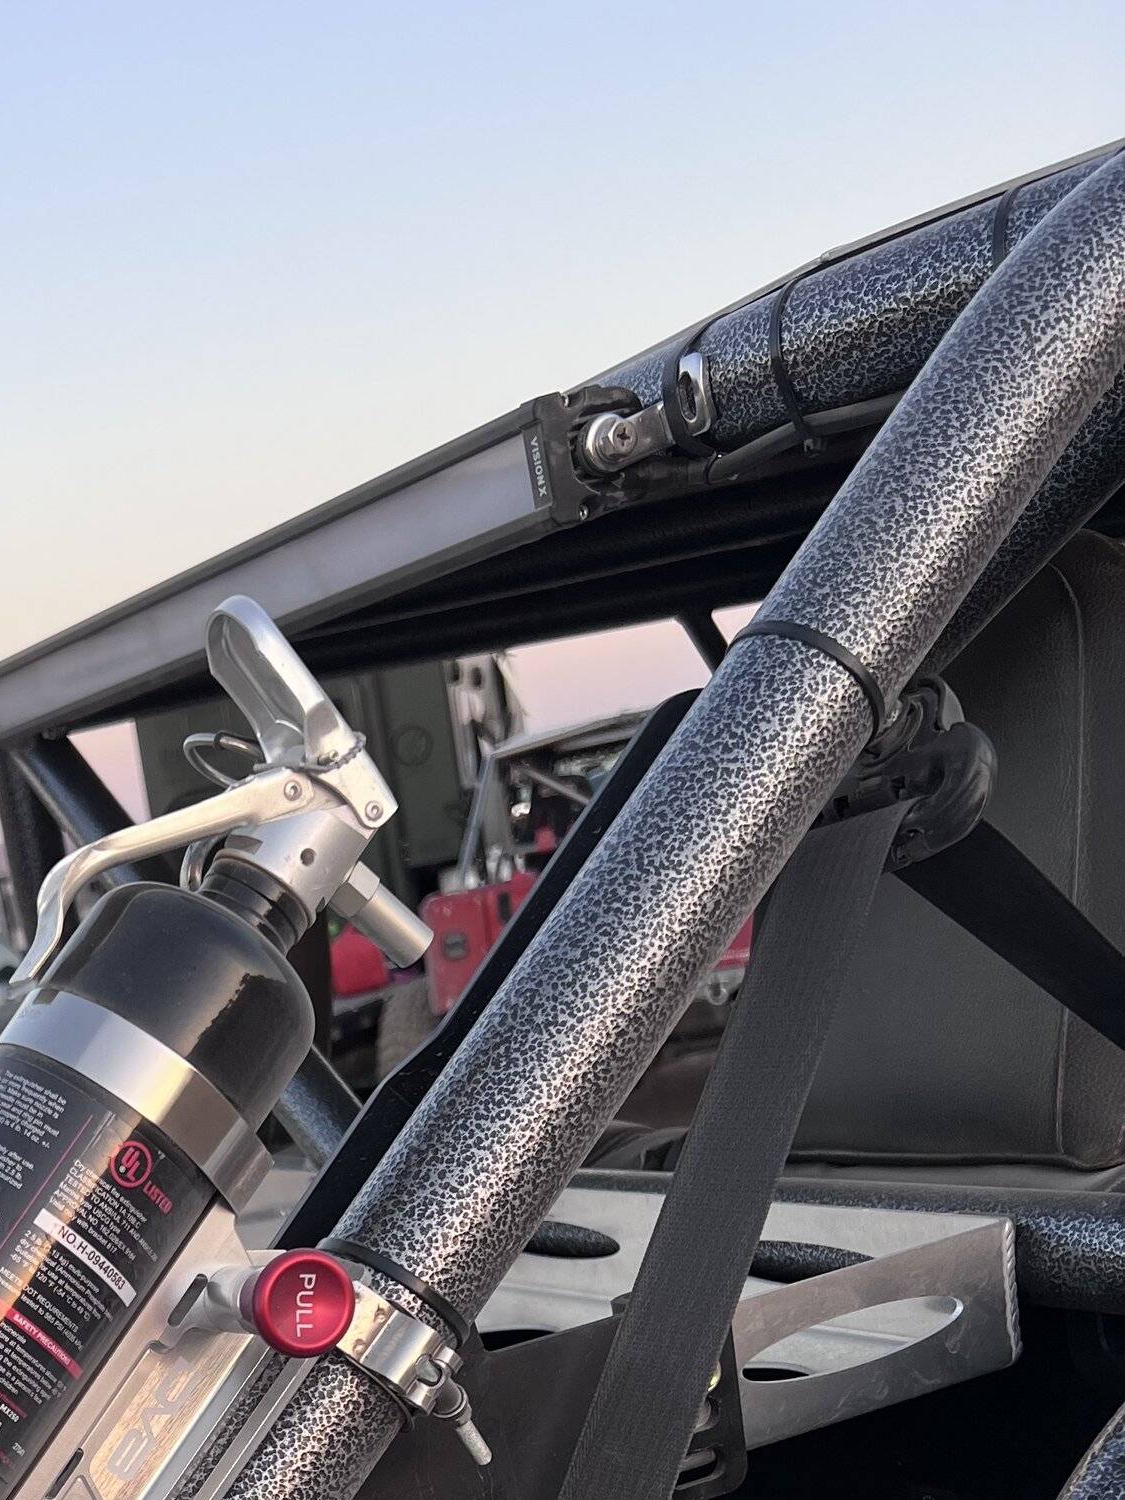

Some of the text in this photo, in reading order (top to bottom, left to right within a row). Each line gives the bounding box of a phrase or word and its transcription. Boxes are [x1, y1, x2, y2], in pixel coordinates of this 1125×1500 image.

[531, 436, 547, 497] VISION X
[14, 1098, 30, 1111] must
[28, 1106, 37, 1115] be
[32, 1100, 53, 1116] nozzle
[46, 1099, 65, 1113] when
[10, 1105, 23, 1115] and
[32, 1117, 44, 1128] pin
[42, 1123, 60, 1137] must
[19, 1119, 45, 1137] charged
[22, 1129, 31, 1137] 14
[7, 1149, 22, 1162] after
[4, 1166, 16, 1176] 2.5
[15, 1163, 22, 1172] to
[73, 1159, 88, 1173] Dry
[109, 1186, 122, 1199] fire
[141, 1179, 175, 1215] LISTED
[89, 1194, 100, 1205] TO
[97, 1200, 123, 1224] ANSI/UL
[119, 1219, 131, 1231] 711
[128, 1227, 141, 1241] AND
[91, 1206, 111, 1225] USCG
[107, 1221, 122, 1235] type
[75, 1217, 89, 1230] with
[86, 1226, 109, 1246] bracket
[18, 1237, 31, 1249] dry
[57, 1254, 70, 1268] kg)
[34, 1270, 48, 1283] 120
[46, 1269, 59, 1281] use
[57, 1277, 65, 1286] at
[19, 1293, 39, 1311] tested
[36, 1306, 46, 1316] to
[21, 1282, 39, 1298] DOT
[34, 1293, 80, 1333] REQUIREMENTS
[295, 1273, 316, 1337] PULL
[11, 1312, 38, 1337] SAFETY
[2, 1346, 12, 1355] at
[8, 1339, 17, 1348] at
[1, 1356, 13, 1368] the
[4, 1370, 12, 1379] in
